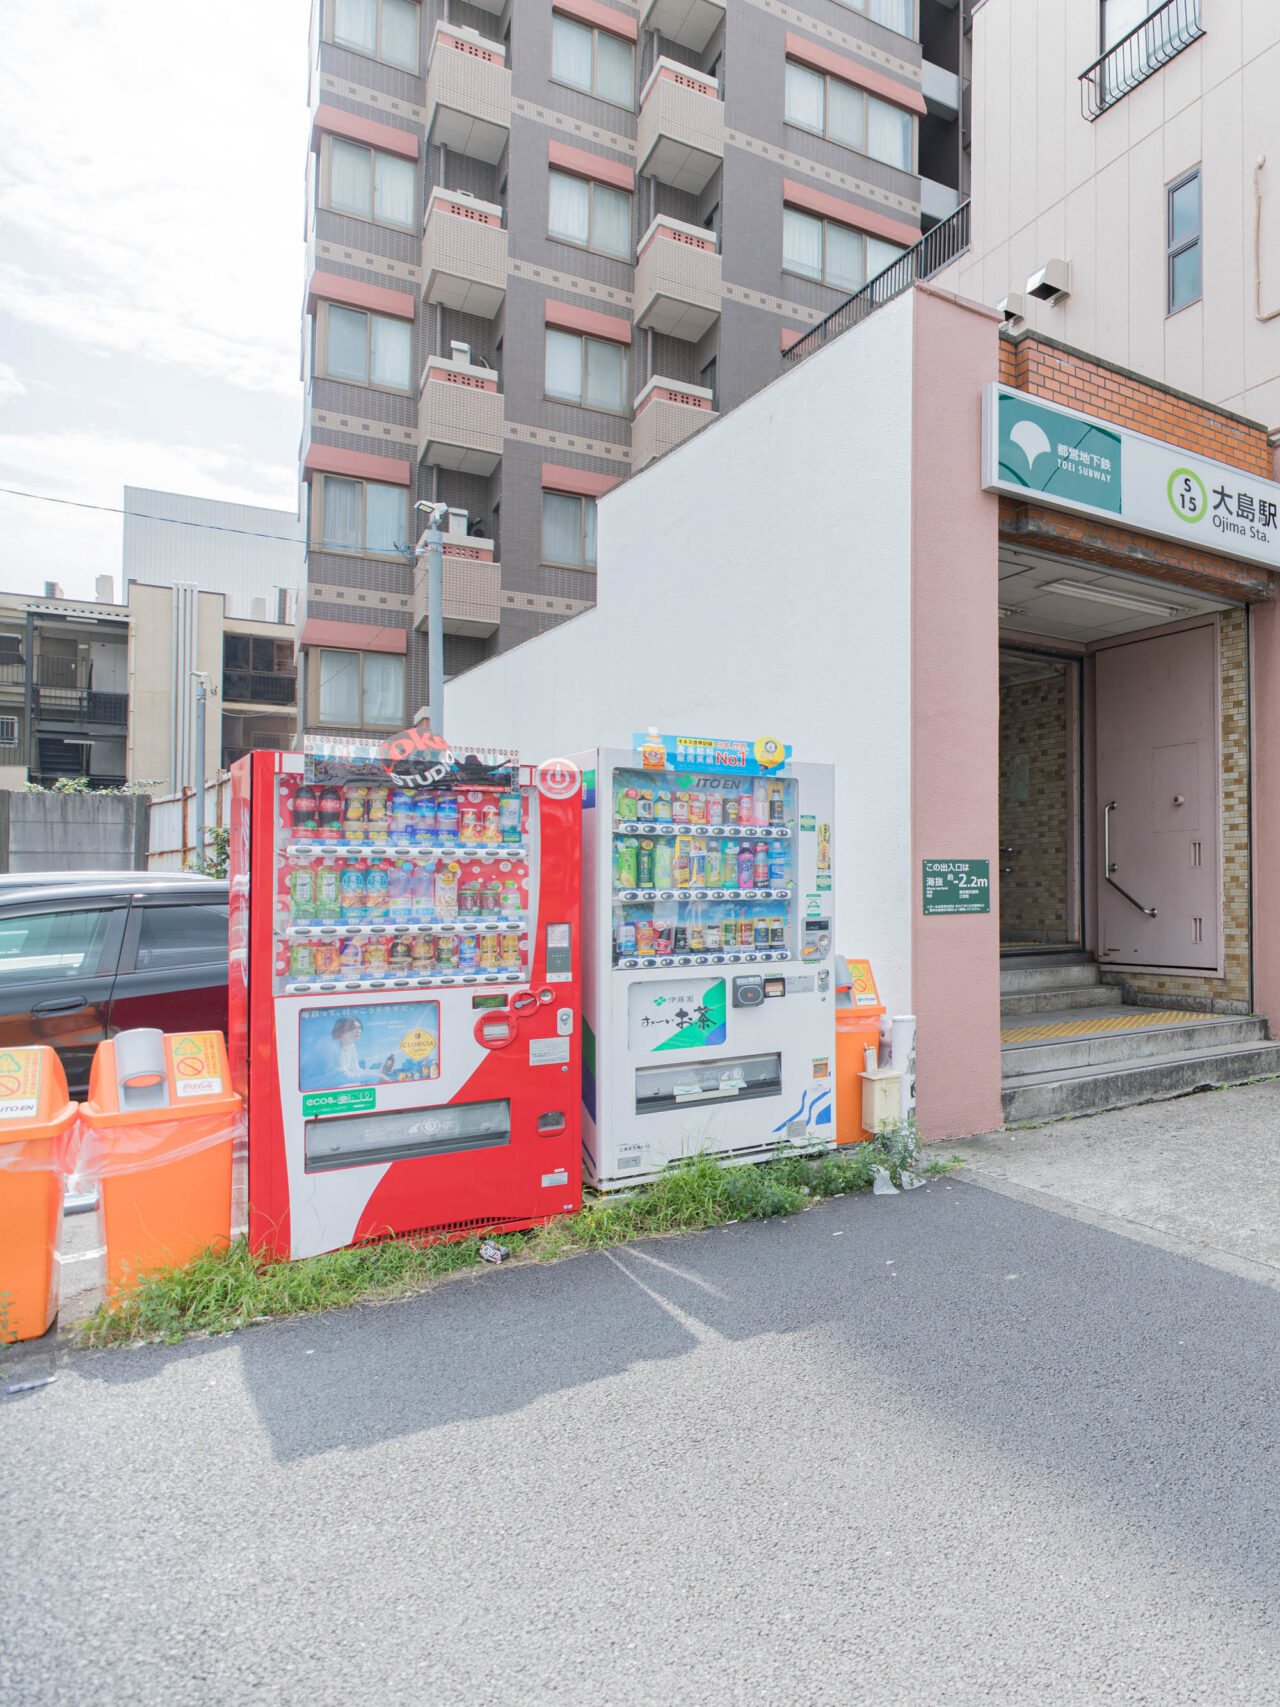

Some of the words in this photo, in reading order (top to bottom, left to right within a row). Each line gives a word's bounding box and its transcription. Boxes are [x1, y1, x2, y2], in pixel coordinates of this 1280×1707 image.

[1057, 443, 1112, 472] 都営地下鉄
[1057, 459, 1076, 472] TOEI
[1078, 464, 1112, 483] SUBWAY
[1183, 477, 1192, 493] S
[1180, 493, 1198, 513] 15
[1212, 485, 1278, 531] 大島駅
[1212, 514, 1247, 537] Ojima
[1249, 526, 1271, 543] Sta.
[716, 751, 746, 767] No.1
[390, 750, 456, 788] STUDIO
[696, 778, 721, 788] ITO
[722, 780, 741, 790] EN
[926, 863, 970, 872] この出入口は
[926, 877, 944, 887] 海抜
[953, 873, 989, 888] -2.2m
[402, 1040, 435, 1049] GEORGIA
